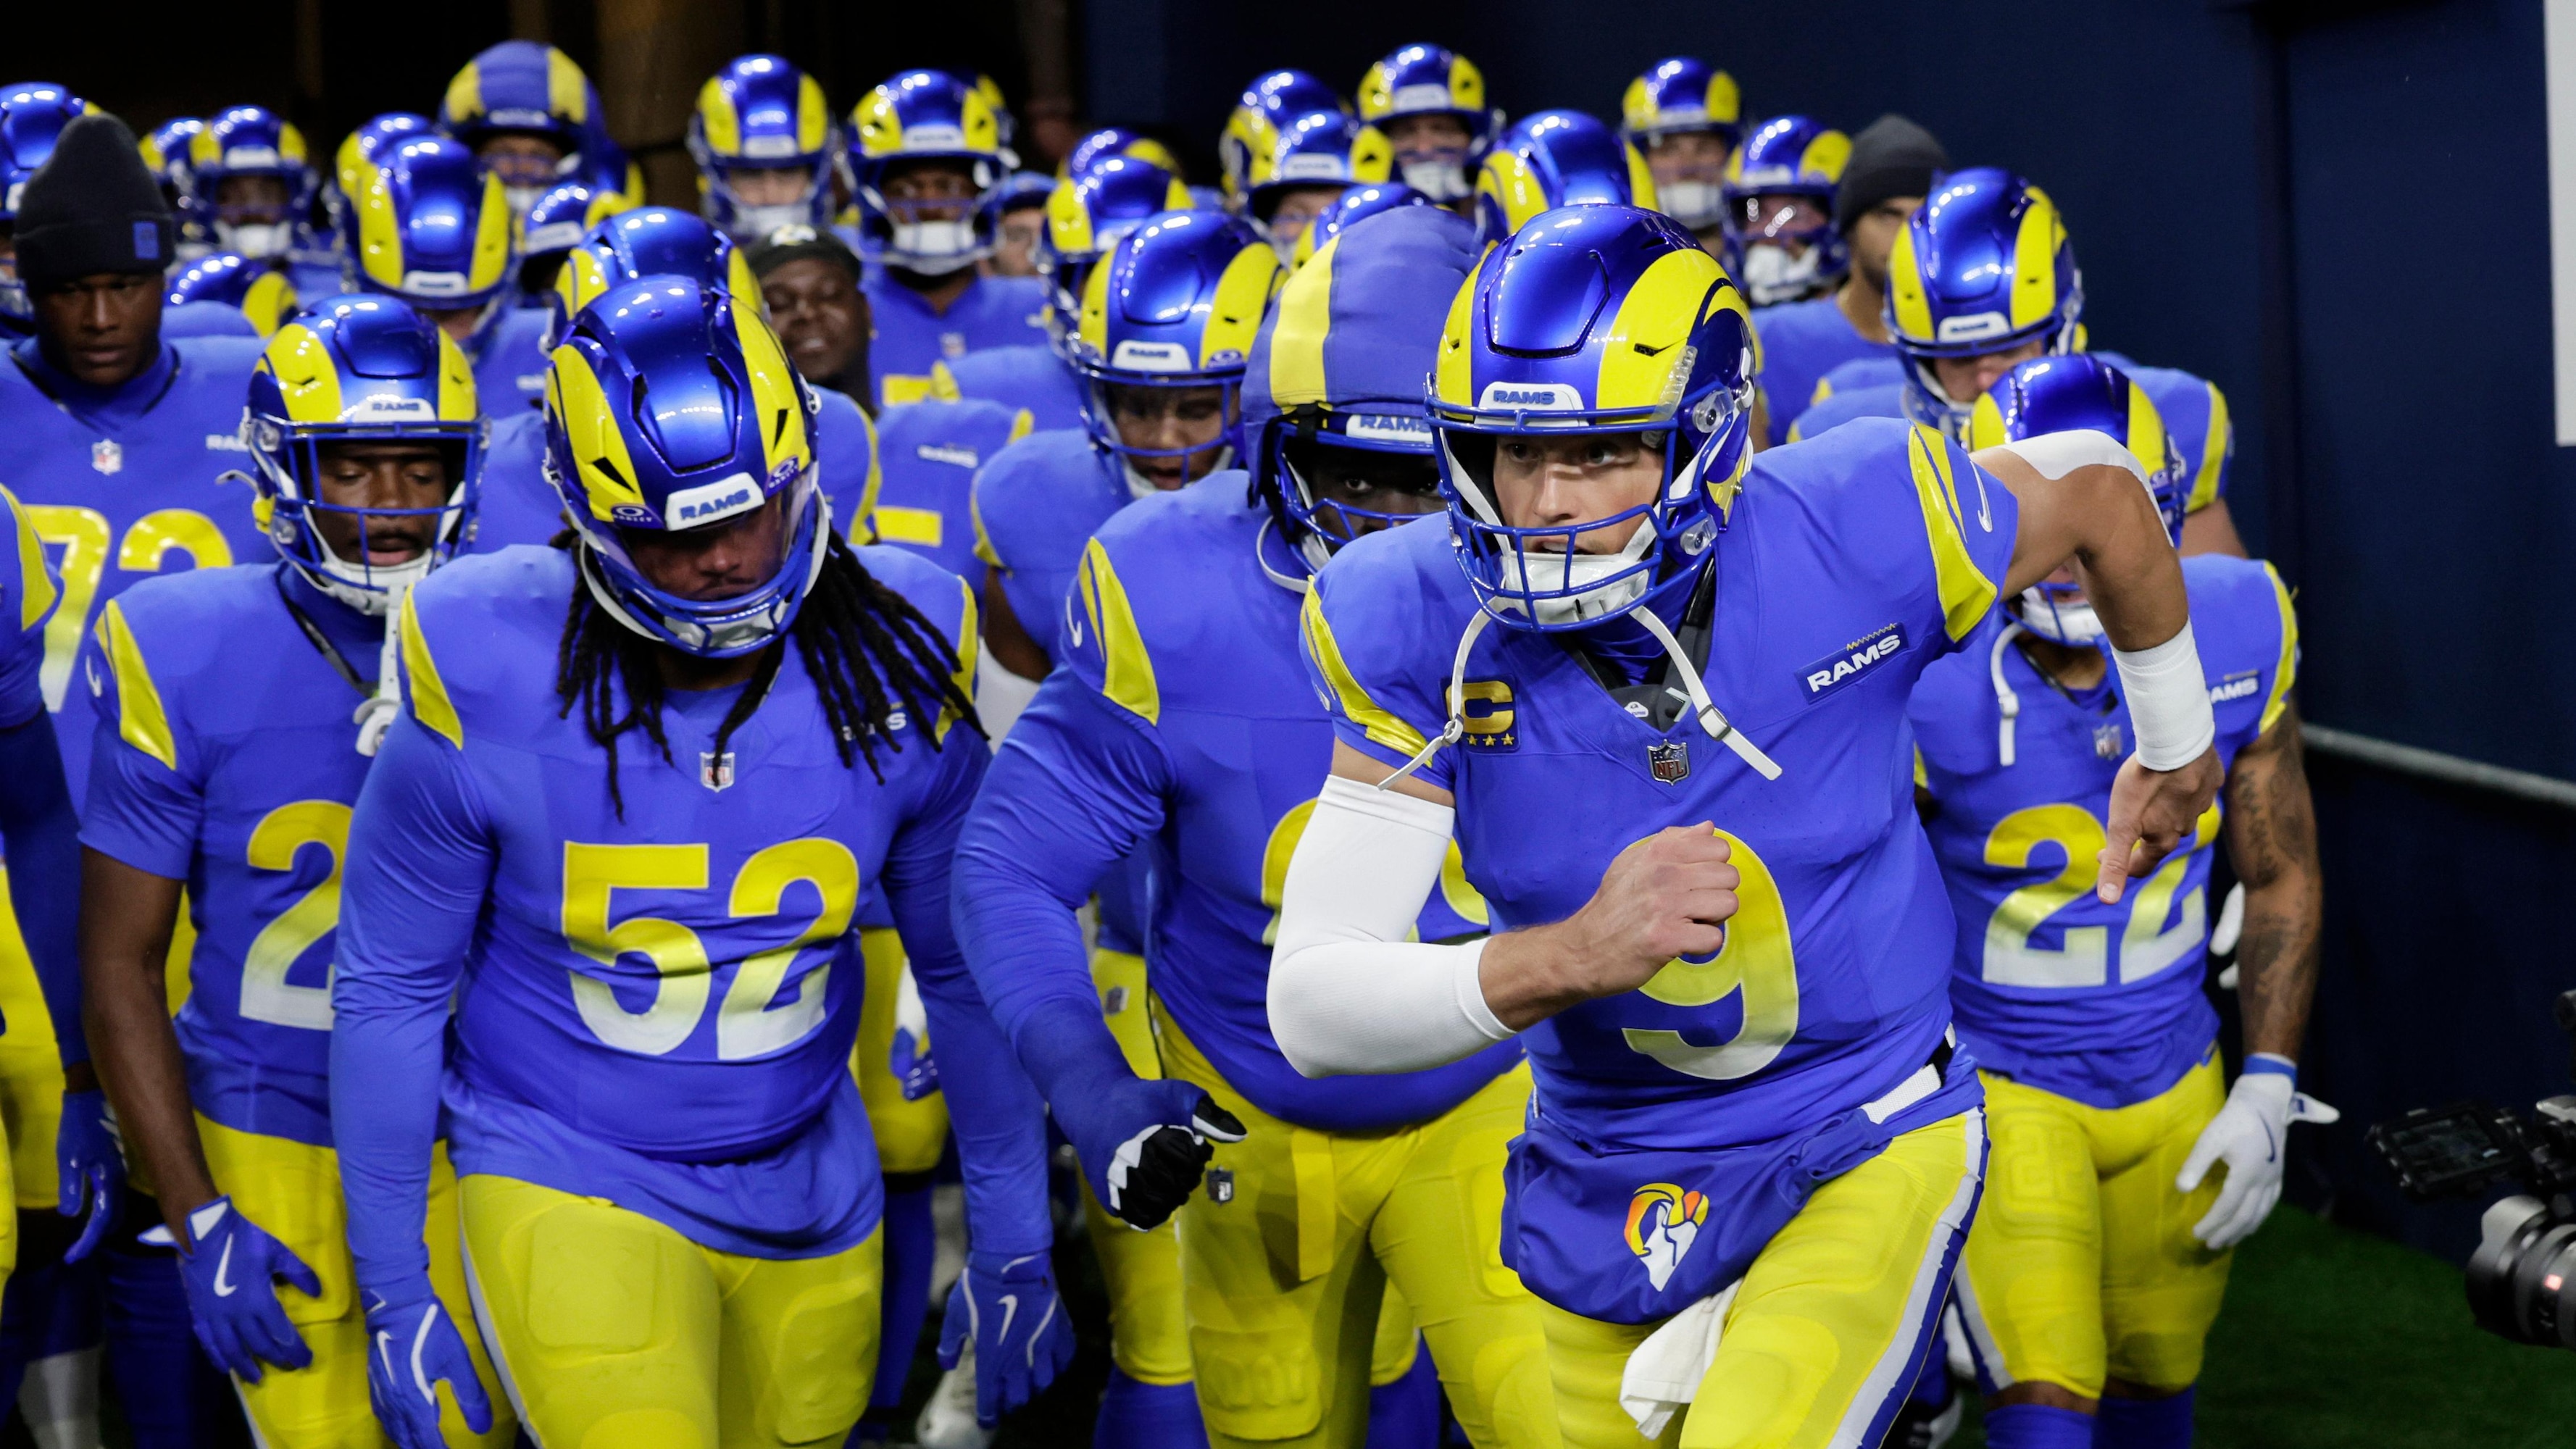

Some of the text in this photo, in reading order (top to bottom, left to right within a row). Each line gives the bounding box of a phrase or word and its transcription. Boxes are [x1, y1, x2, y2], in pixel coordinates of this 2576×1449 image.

[1493, 390, 1556, 405] RAMS
[680, 489, 751, 521] RAMS
[1807, 634, 1901, 693] RAMS
[2210, 677, 2259, 703] AMS
[1445, 681, 1514, 735] C
[1656, 761, 1684, 777] NFL
[238, 799, 354, 1032] 2
[1982, 797, 2222, 988] 22
[562, 837, 860, 1061] 52
[1621, 827, 1799, 1080] 9
